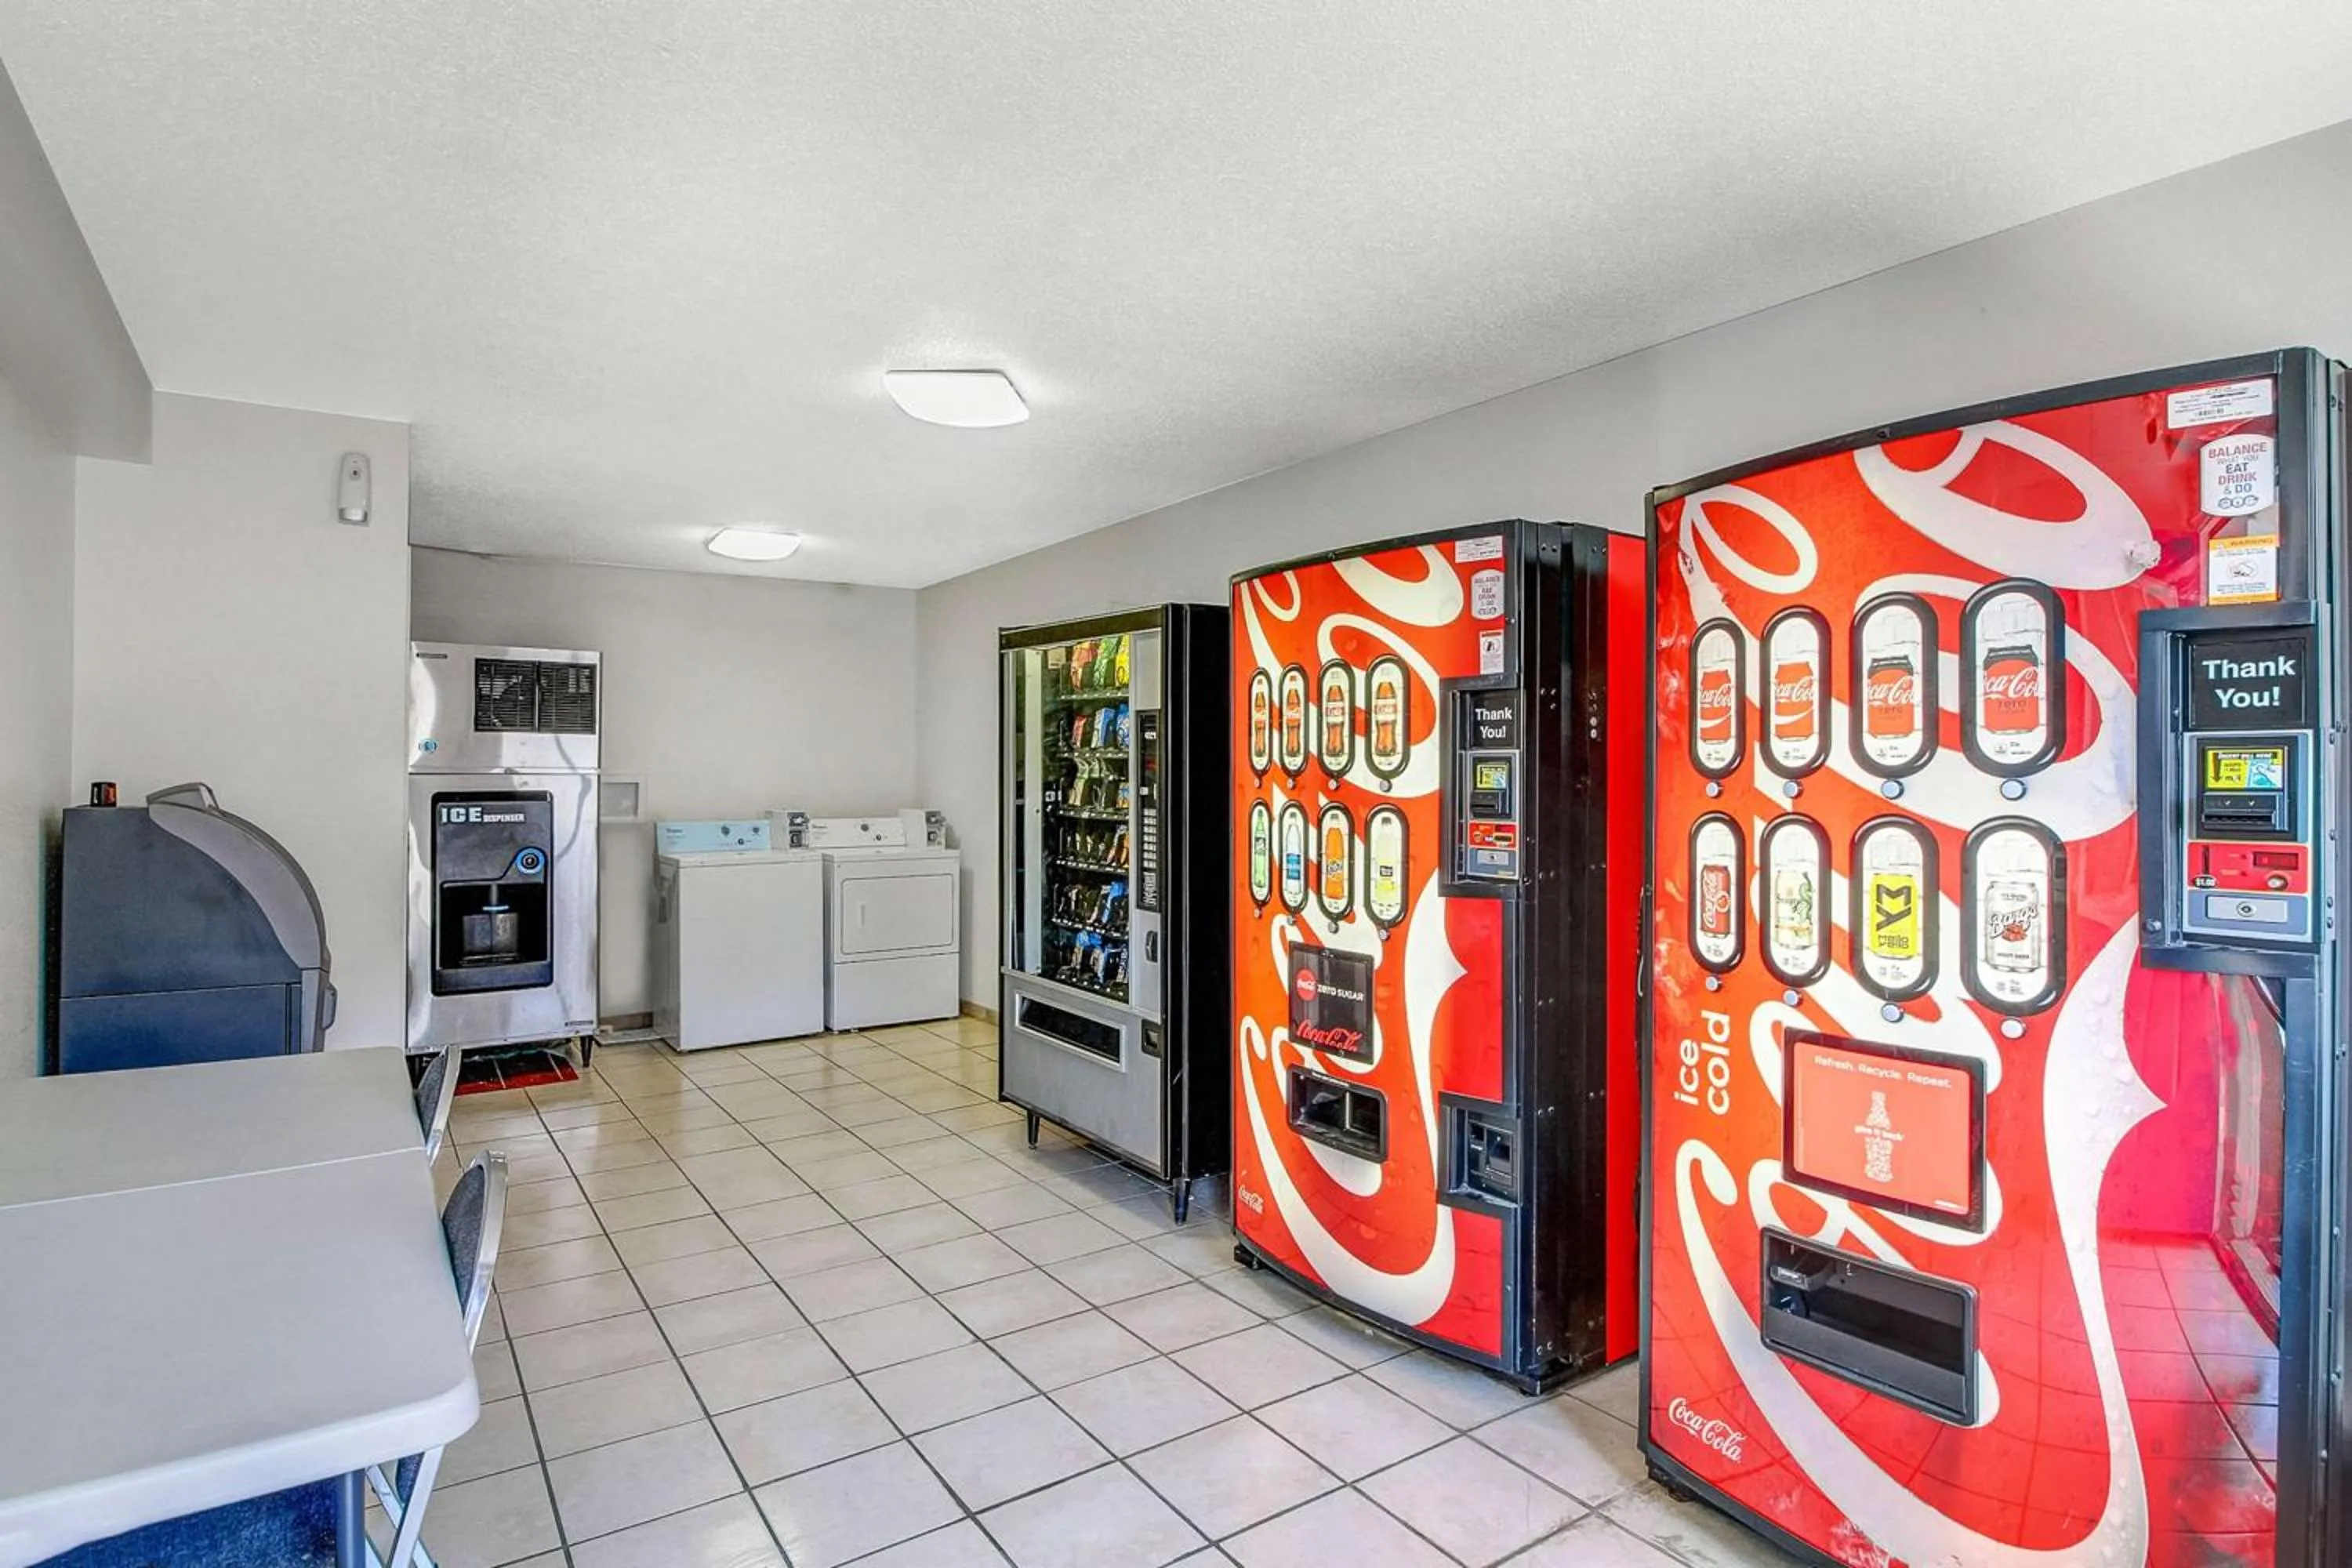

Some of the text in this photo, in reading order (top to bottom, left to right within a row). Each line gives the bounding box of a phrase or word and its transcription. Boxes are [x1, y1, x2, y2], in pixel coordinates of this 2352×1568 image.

[2209, 442, 2267, 459] BALANCE
[2226, 462, 2249, 474] EAT
[2218, 471, 2257, 485] DRINK
[2234, 482, 2252, 493] DO
[2201, 655, 2296, 679] Thank
[2215, 687, 2281, 708] You!
[1475, 706, 1512, 720] Thank
[1480, 726, 1506, 739] You!
[441, 807, 482, 822] ICE
[1338, 989, 1364, 1002] SUGAR
[1701, 1011, 1730, 1116] cold
[1674, 1039, 1699, 1106] ice
[1907, 1071, 1952, 1089] Repeat.
[1668, 1396, 1748, 1462] Coca-Cola
